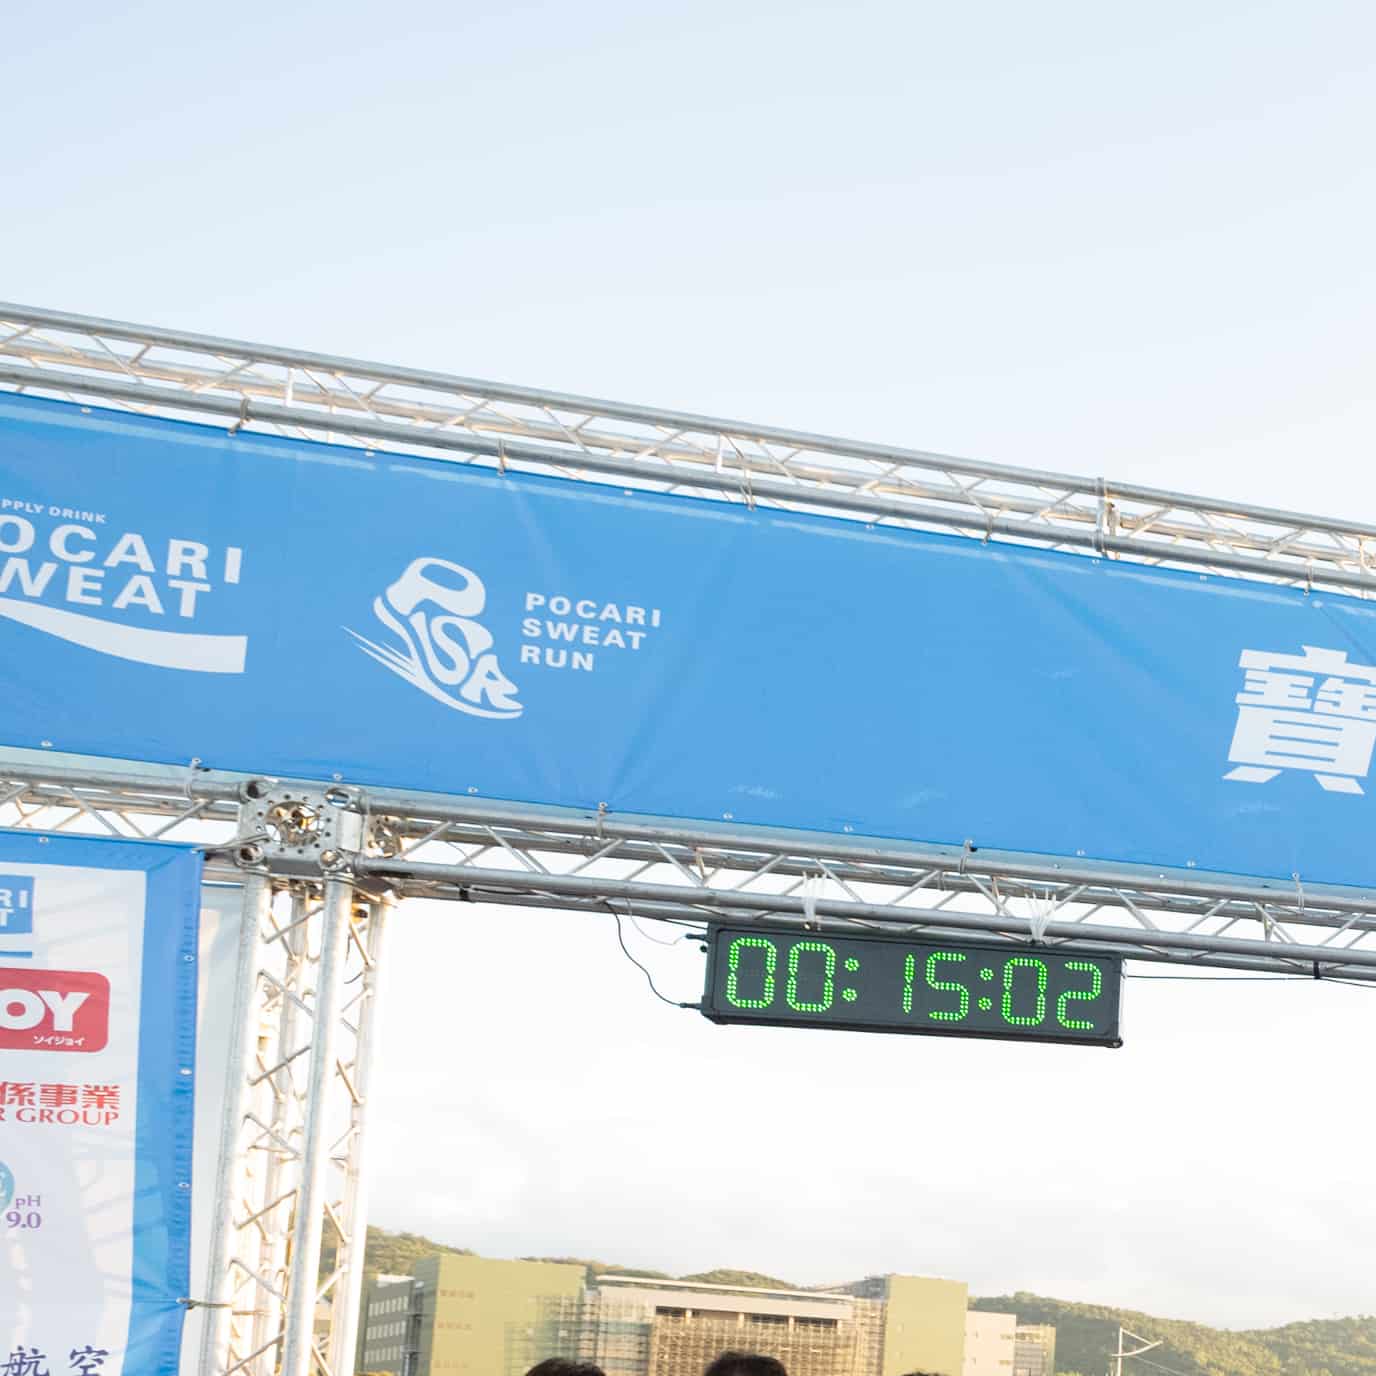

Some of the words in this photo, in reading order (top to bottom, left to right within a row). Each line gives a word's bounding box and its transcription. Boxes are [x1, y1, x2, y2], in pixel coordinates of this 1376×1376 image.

[48, 506, 107, 524] DRINK
[525, 592, 661, 628] POCARI
[522, 618, 647, 650] SWEAT
[520, 645, 595, 673] RUN
[726, 936, 1103, 1031] 00:15:02
[32, 1035, 86, 1047] ソイジョイ
[15, 1108, 120, 1127] GROUP
[15, 1194, 41, 1210] pH
[6, 1210, 42, 1229] 9.0
